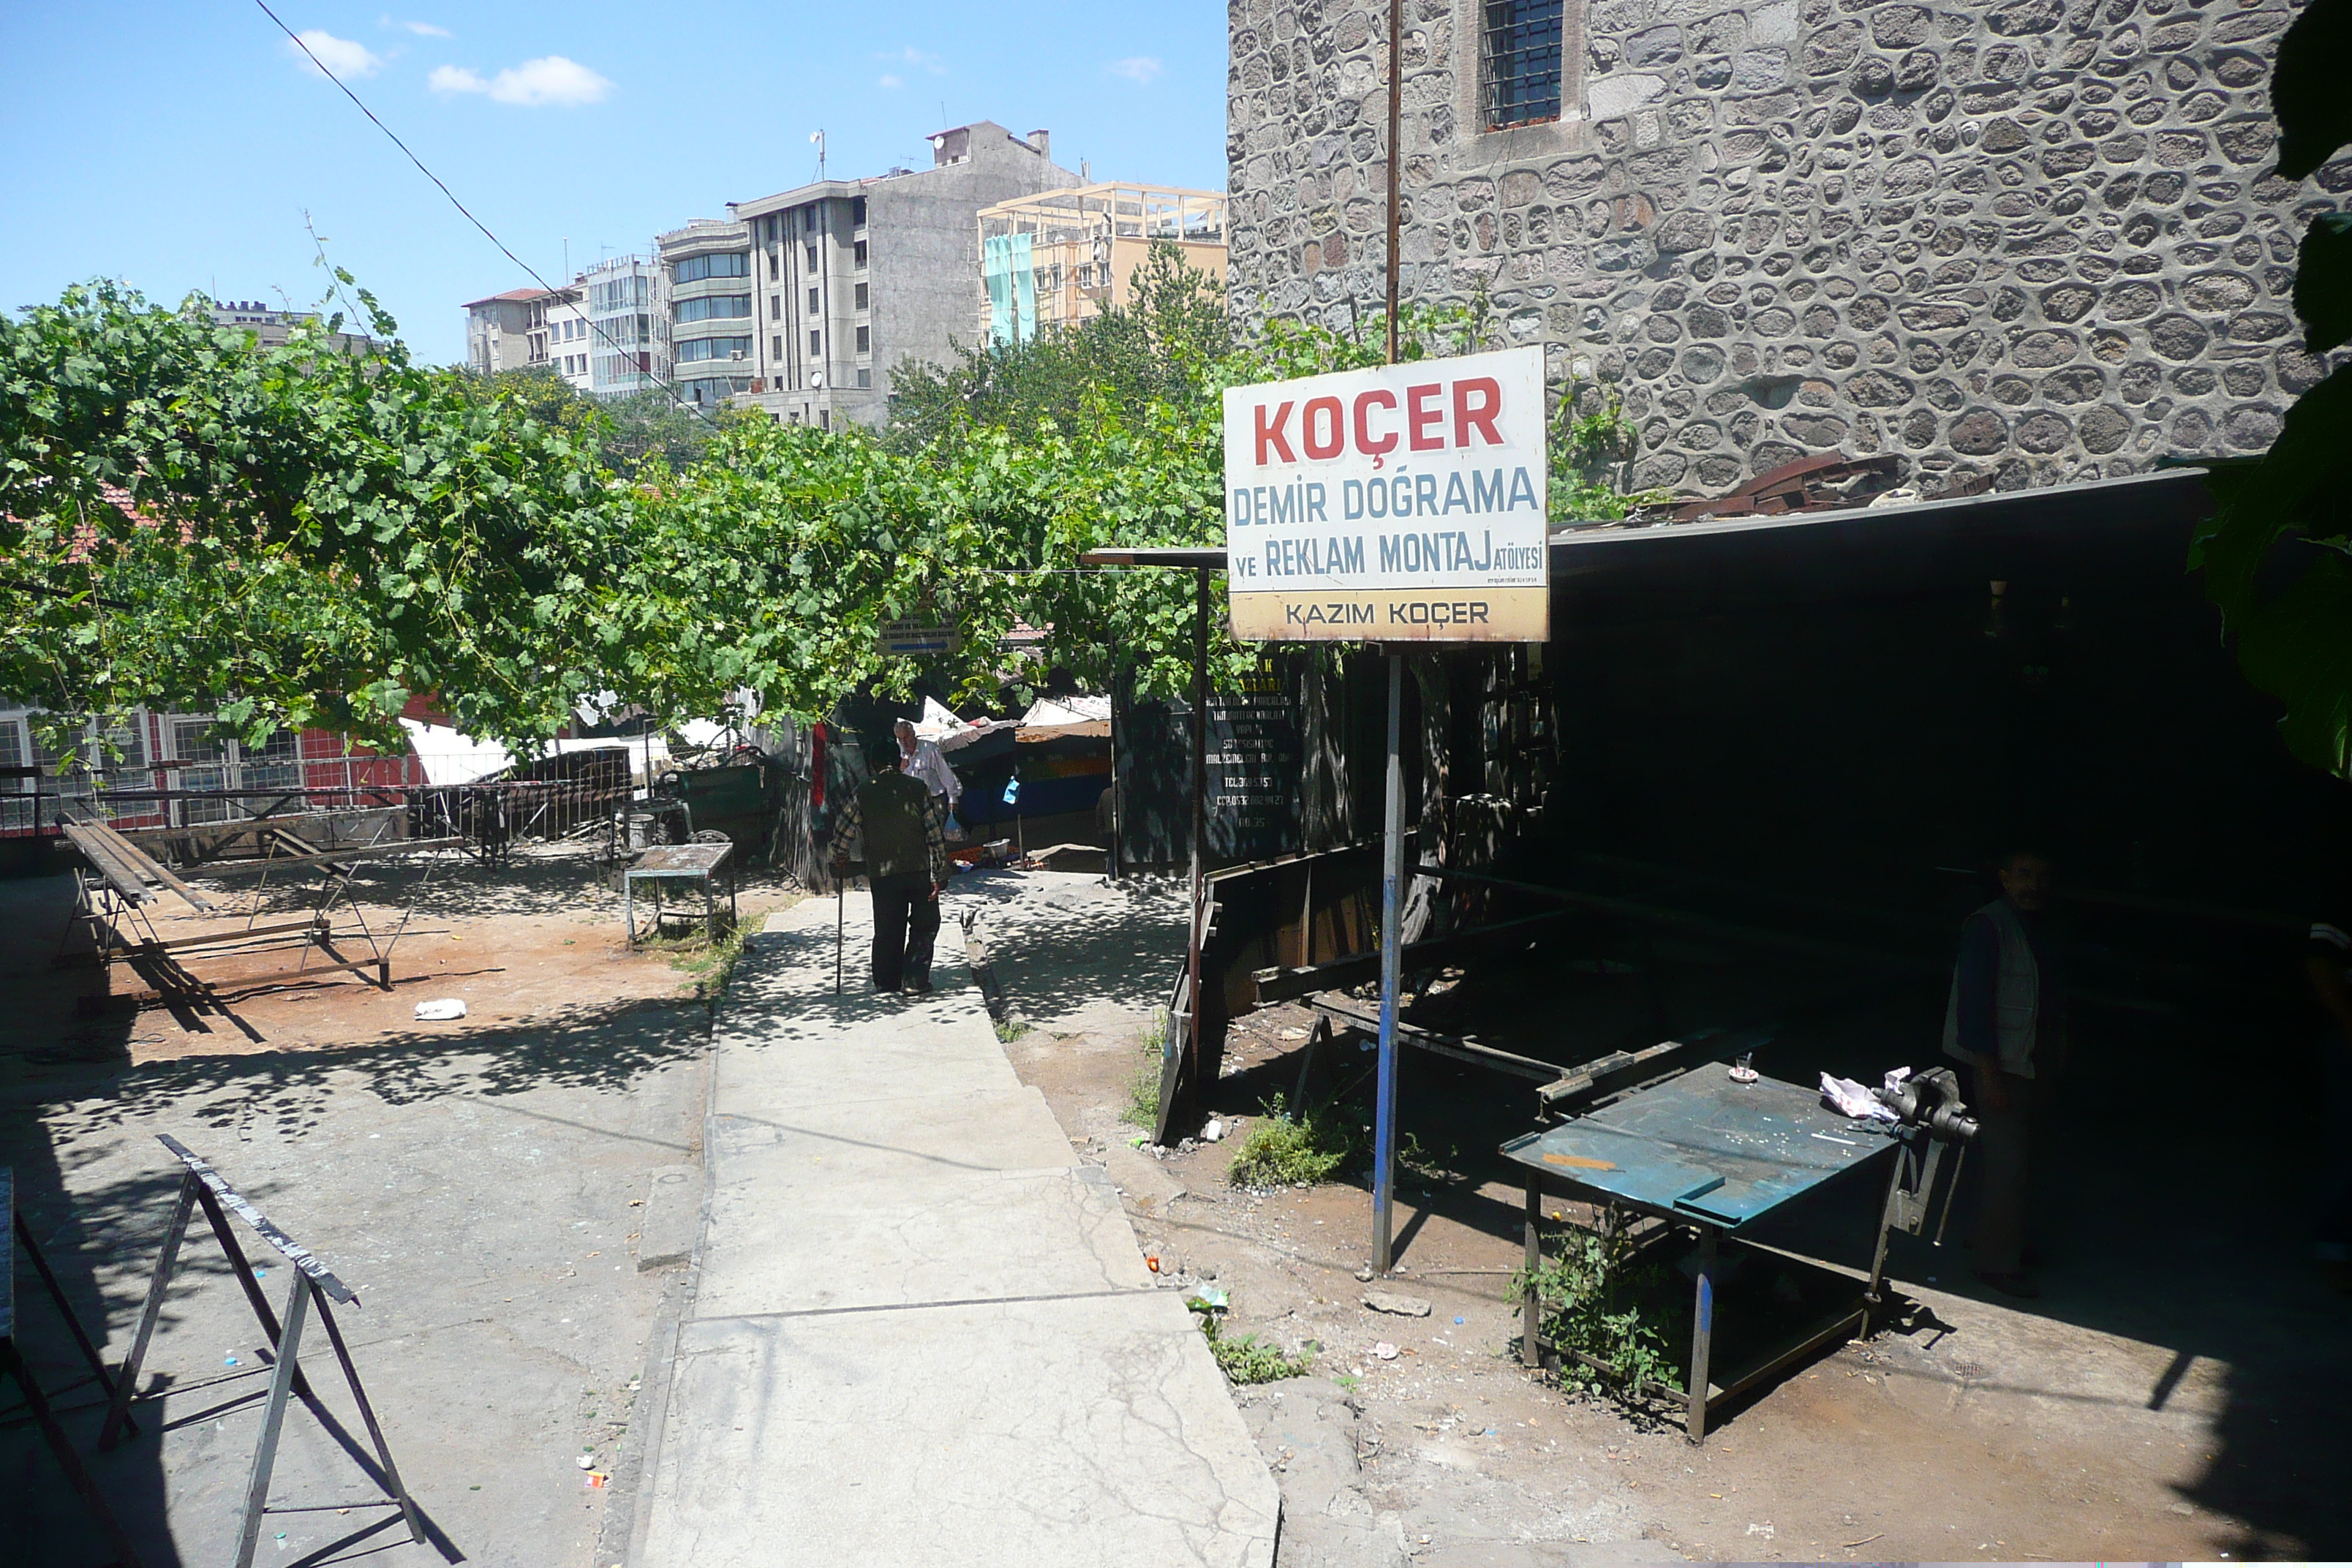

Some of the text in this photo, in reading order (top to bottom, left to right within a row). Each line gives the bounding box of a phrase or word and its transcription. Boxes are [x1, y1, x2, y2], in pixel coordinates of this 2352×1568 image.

[1254, 376, 1504, 470] KOÇER
[1234, 464, 1538, 527] DEMİR DOĞRAMA
[1235, 529, 1543, 578] VE REKLAM MONTAJ ATÖLYESİ
[1286, 601, 1490, 630] KAZIM KOÇER
